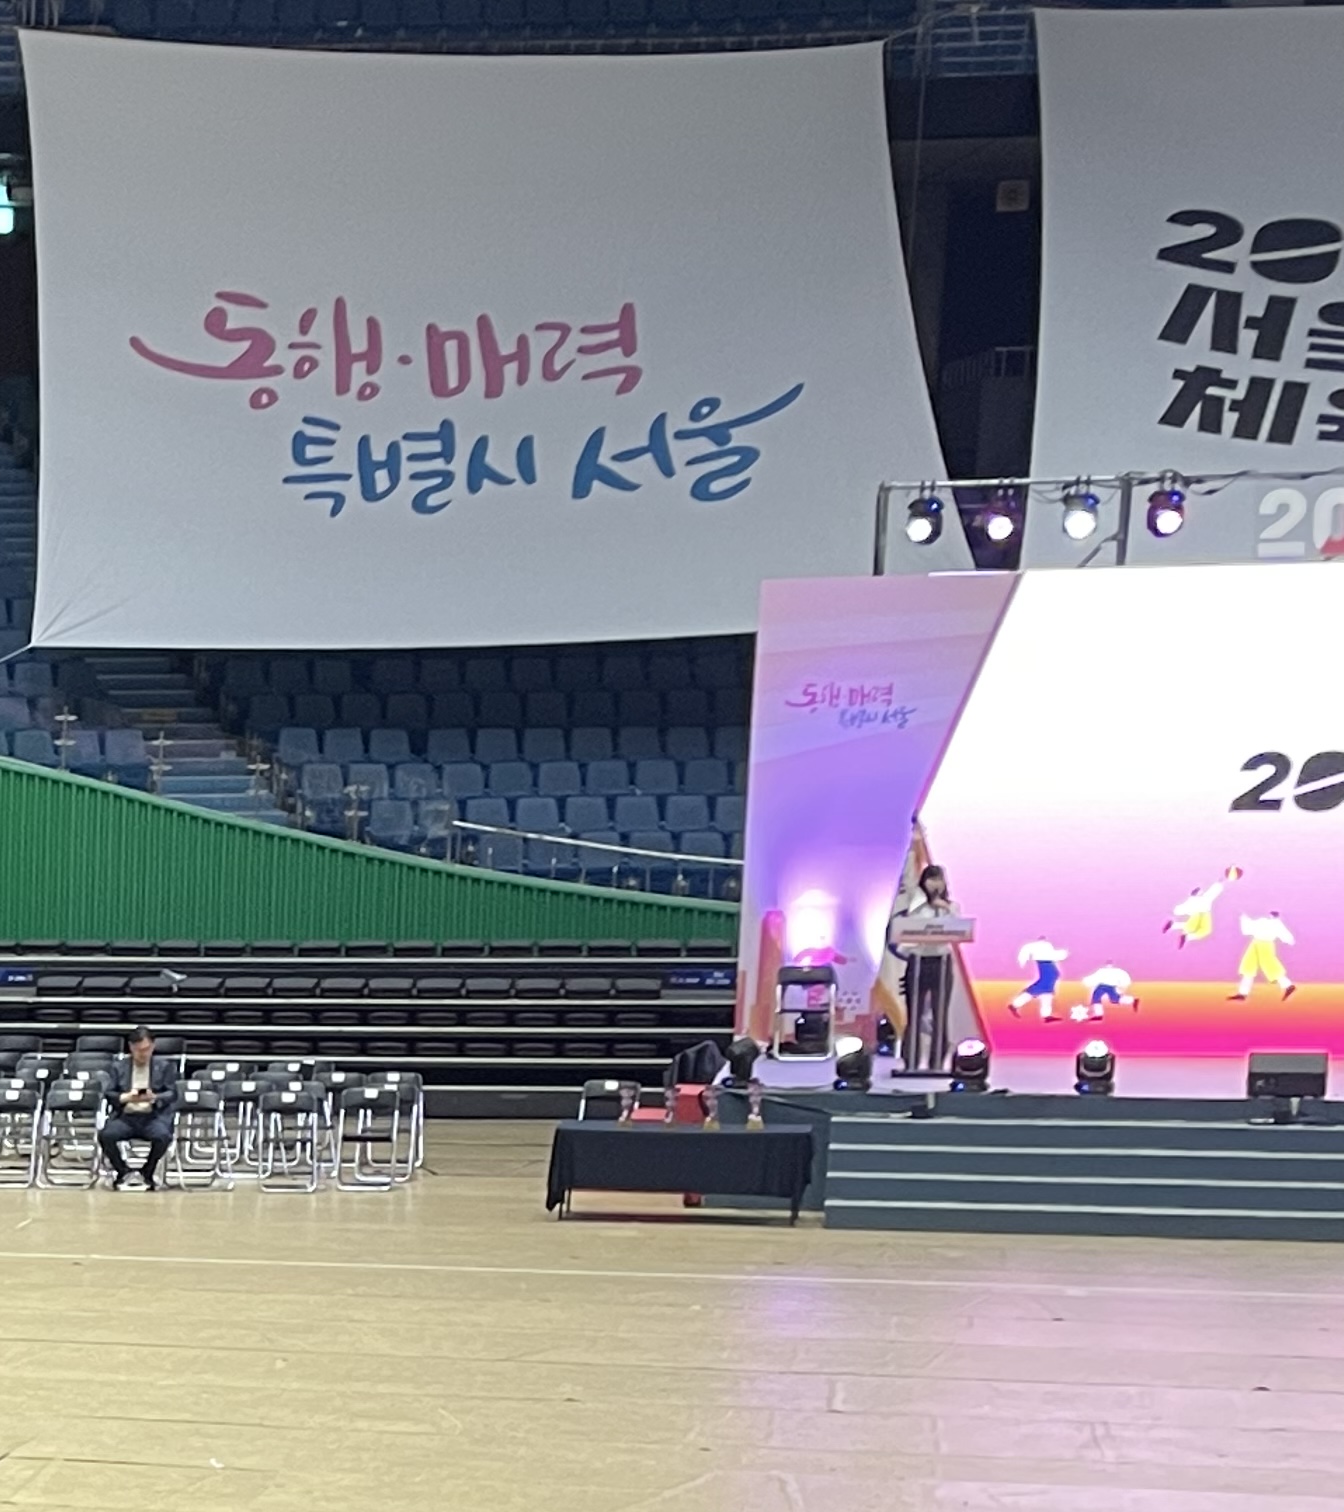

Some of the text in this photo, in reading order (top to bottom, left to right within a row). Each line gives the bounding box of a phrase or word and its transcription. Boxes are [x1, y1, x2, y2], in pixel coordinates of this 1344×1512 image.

[283, 382, 806, 519] 특별시 서울
[1157, 365, 1344, 446] 체
